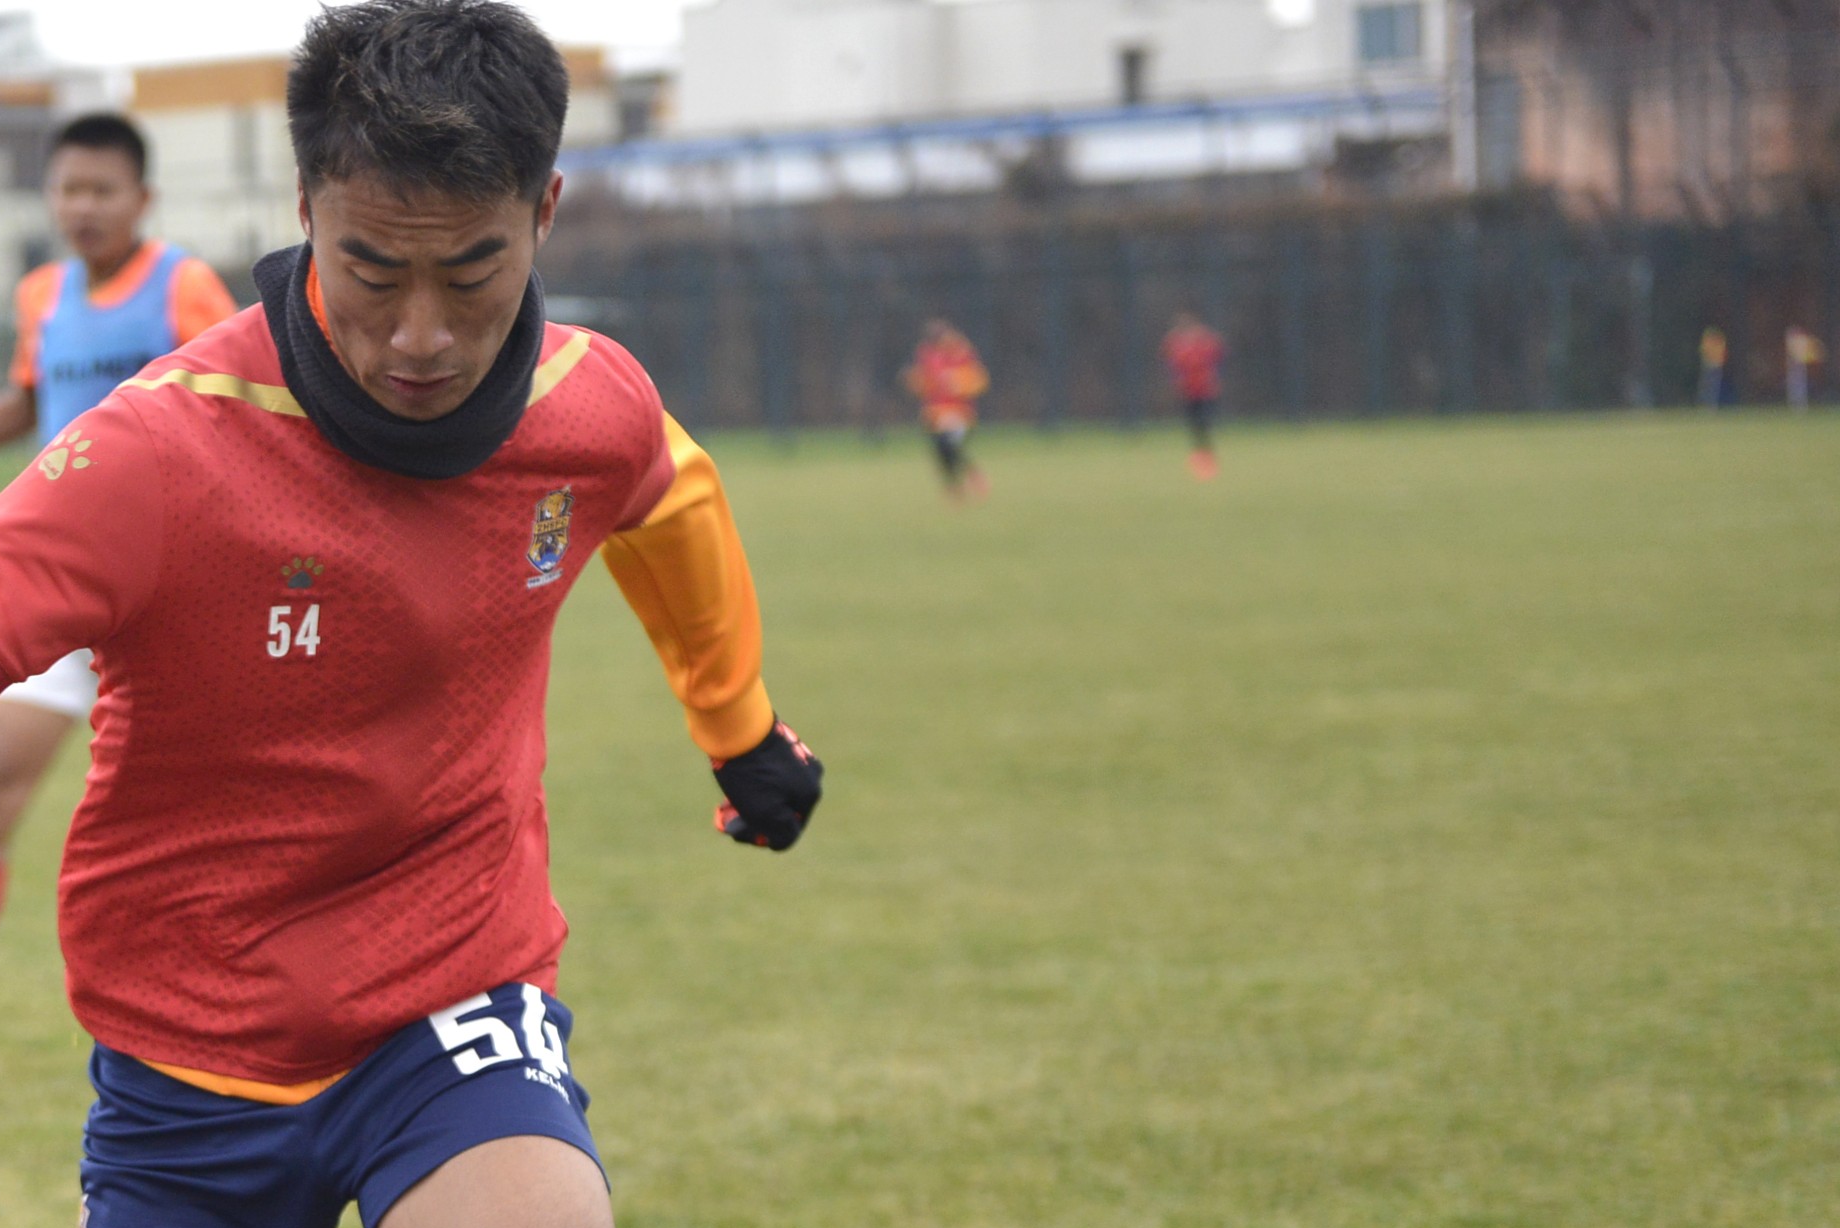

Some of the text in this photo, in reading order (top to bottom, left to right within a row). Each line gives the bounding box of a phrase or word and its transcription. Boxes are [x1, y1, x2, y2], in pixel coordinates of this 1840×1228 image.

[267, 603, 321, 658] 54
[428, 982, 569, 1080] 54
[524, 1066, 570, 1105] KELM
